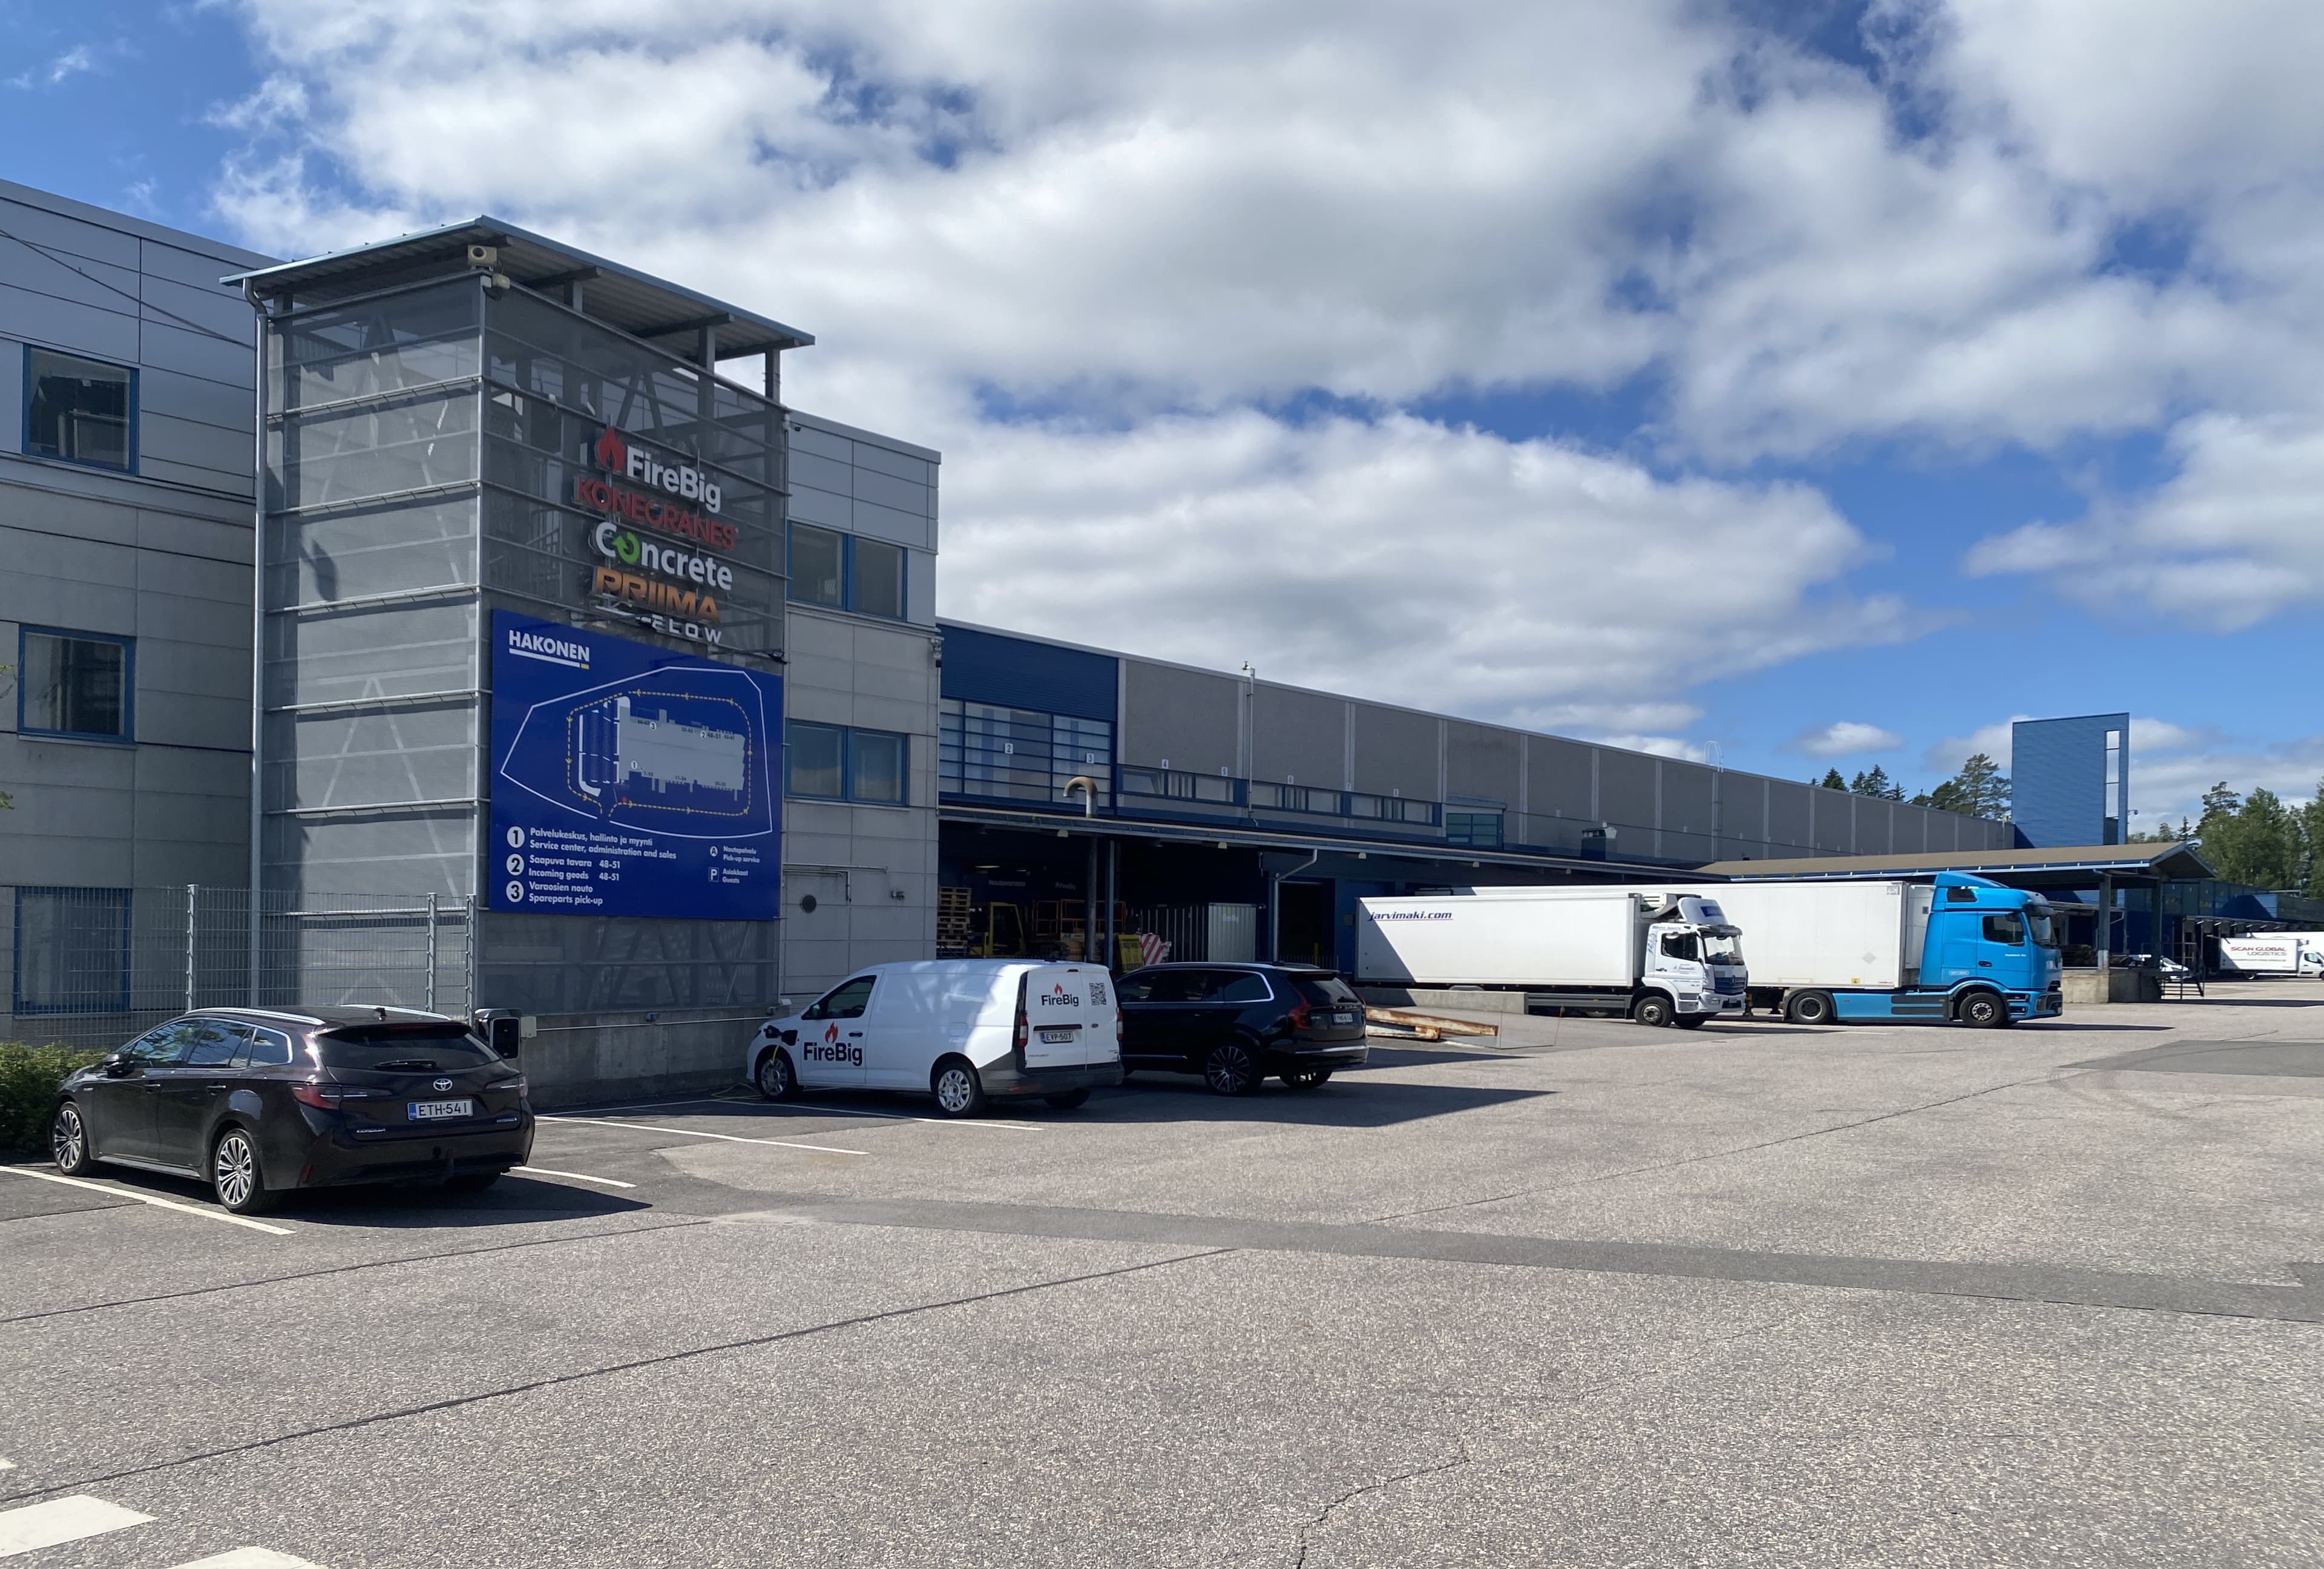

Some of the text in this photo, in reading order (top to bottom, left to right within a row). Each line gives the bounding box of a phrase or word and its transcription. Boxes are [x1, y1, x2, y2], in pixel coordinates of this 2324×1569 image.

[626, 444, 721, 514] FireBig
[577, 475, 736, 551] KONECRANES
[595, 521, 733, 591] Concrete
[594, 565, 721, 625] PRIIMA
[508, 630, 590, 662] HAKONEN
[513, 830, 519, 845] 1
[530, 827, 653, 847] Palvelukeskus, hallinto ja myynti
[530, 839, 677, 860] Service center, administration and sales
[511, 857, 520, 873] 2
[530, 854, 621, 869] Saapuva tavara 48-51
[528, 867, 620, 881] Incoming goods 48-51
[711, 869, 718, 881] P
[510, 884, 520, 900] 3
[529, 881, 570, 891] Varaosien
[529, 893, 603, 906] Spareparts pick-up
[1368, 911, 1452, 921] jarvimaki.com
[1040, 993, 1080, 1007] FireBig
[803, 1041, 863, 1067] FireBig
[418, 1102, 468, 1117] ETH-541
